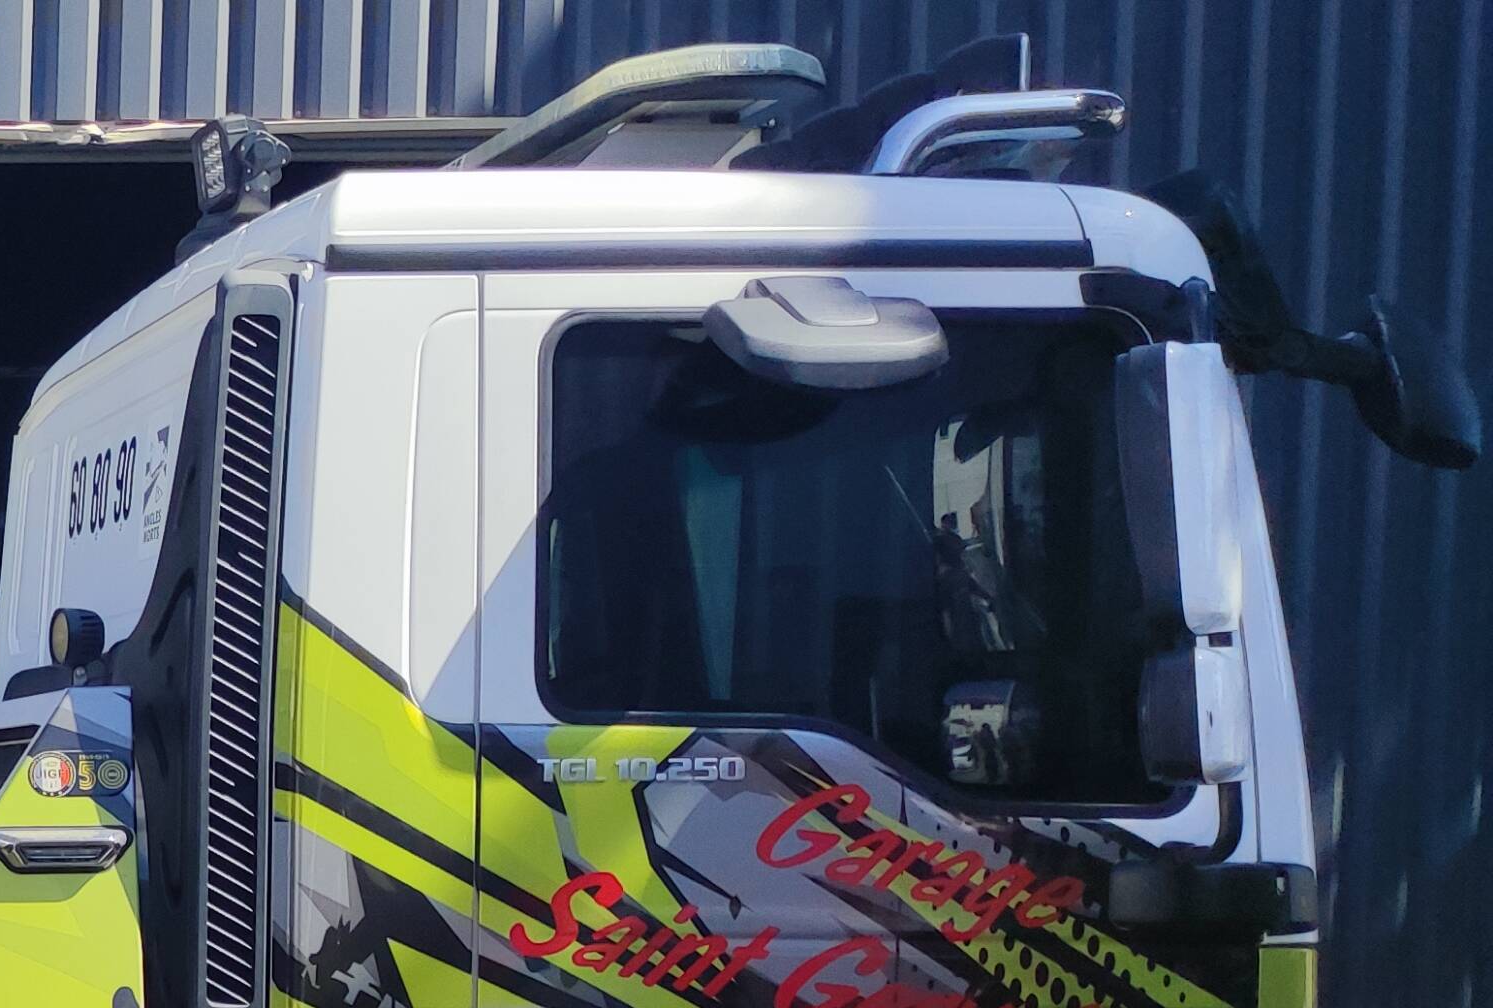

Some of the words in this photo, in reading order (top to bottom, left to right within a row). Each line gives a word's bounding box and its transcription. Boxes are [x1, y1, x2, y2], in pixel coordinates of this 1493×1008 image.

[68, 456, 87, 539] 60
[90, 447, 112, 533] 80
[114, 436, 137, 523] 90
[536, 757, 606, 782] TGL
[615, 757, 746, 782] 10.250
[756, 783, 1090, 941] Garage
[509, 871, 781, 1000] Saint
